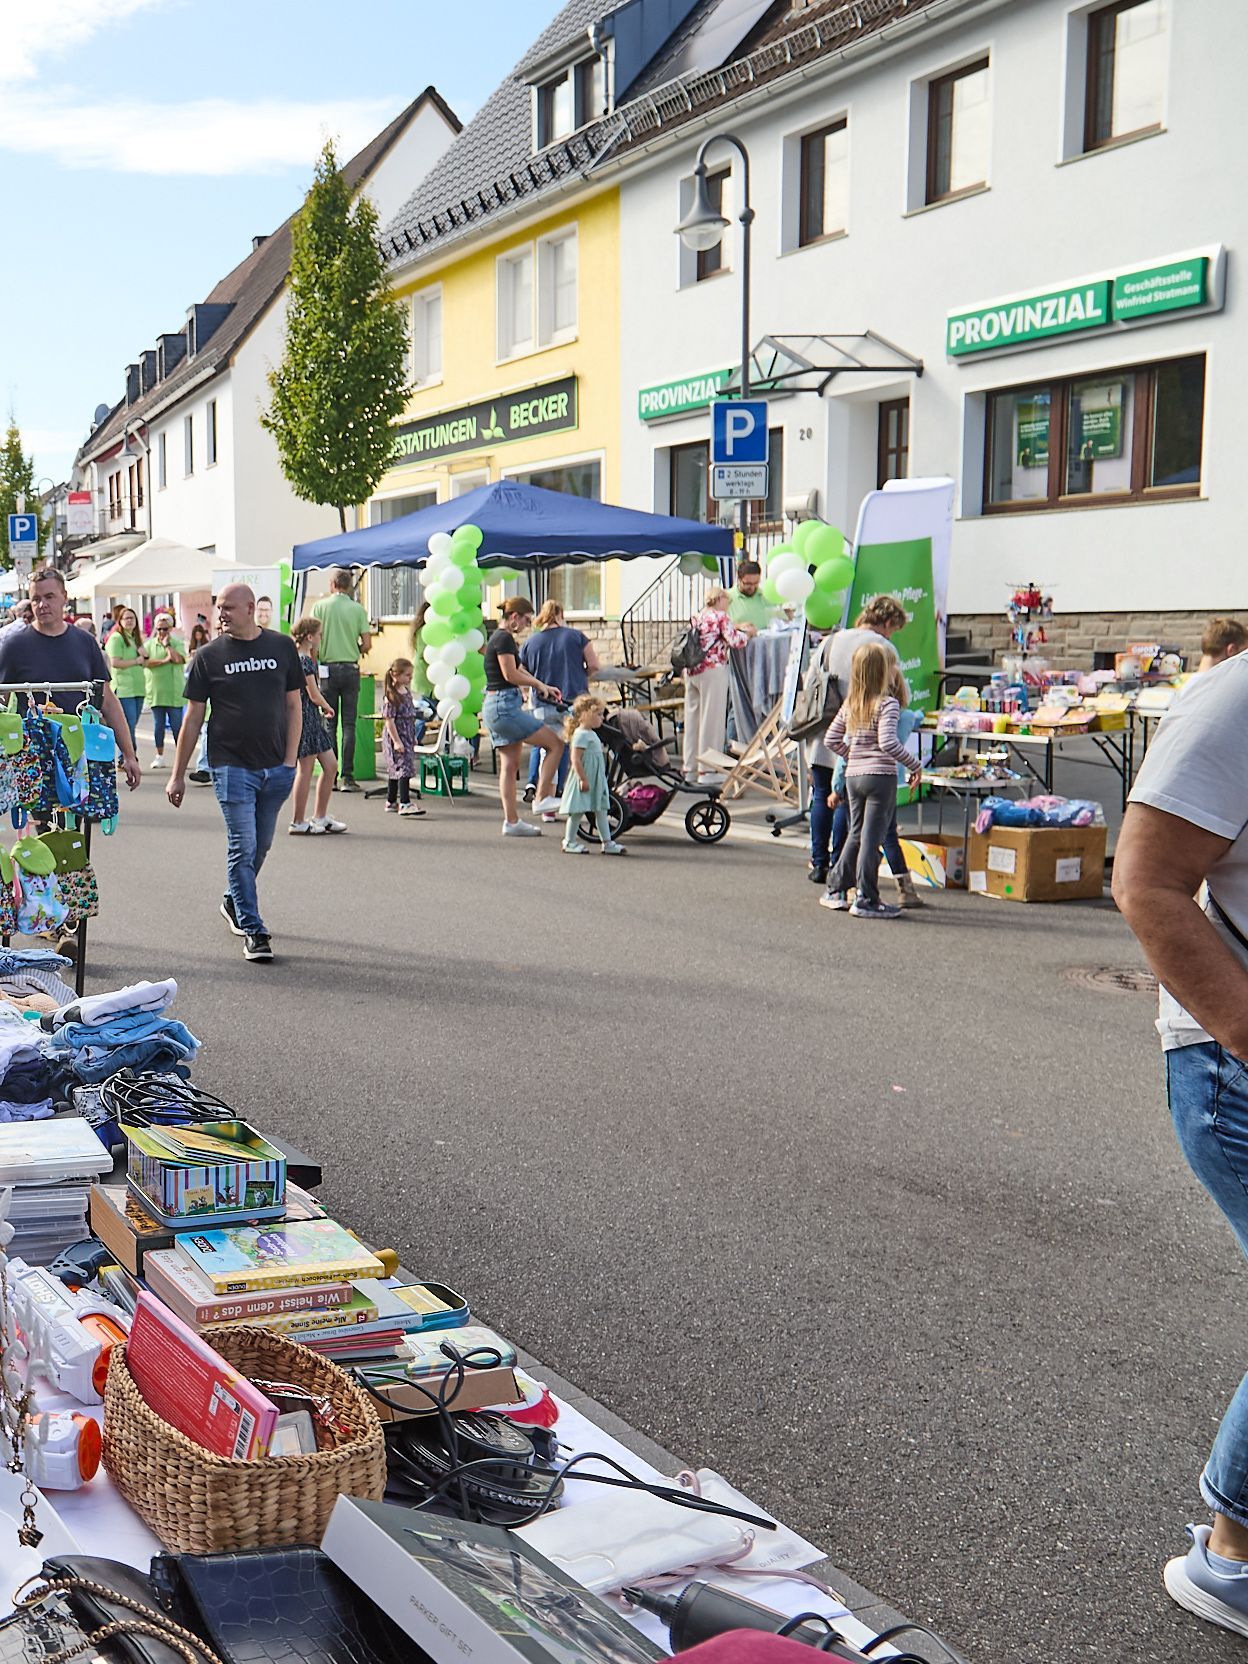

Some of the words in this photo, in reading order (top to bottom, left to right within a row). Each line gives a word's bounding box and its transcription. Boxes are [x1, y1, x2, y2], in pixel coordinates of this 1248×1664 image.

[1153, 284, 1200, 304] Stratmann
[949, 289, 1102, 348] PROVINZIAL
[509, 392, 569, 430] BECKER
[725, 408, 756, 456] P
[799, 427, 813, 441] 20
[734, 468, 763, 478] Stunden
[15, 518, 30, 540] P
[224, 657, 278, 675] umbro
[301, 1274, 333, 1283] Findebuch
[279, 1295, 313, 1311] heisst
[316, 1291, 340, 1305] Wie
[246, 1300, 275, 1314] denn
[290, 1320, 310, 1330] Sinne
[312, 1318, 333, 1326] meine
[334, 1315, 347, 1324] Alle
[758, 1552, 791, 1568] QUALITY
[410, 1595, 439, 1628] PARKER
[439, 1622, 458, 1643] GIFT
[458, 1638, 474, 1657] SET
